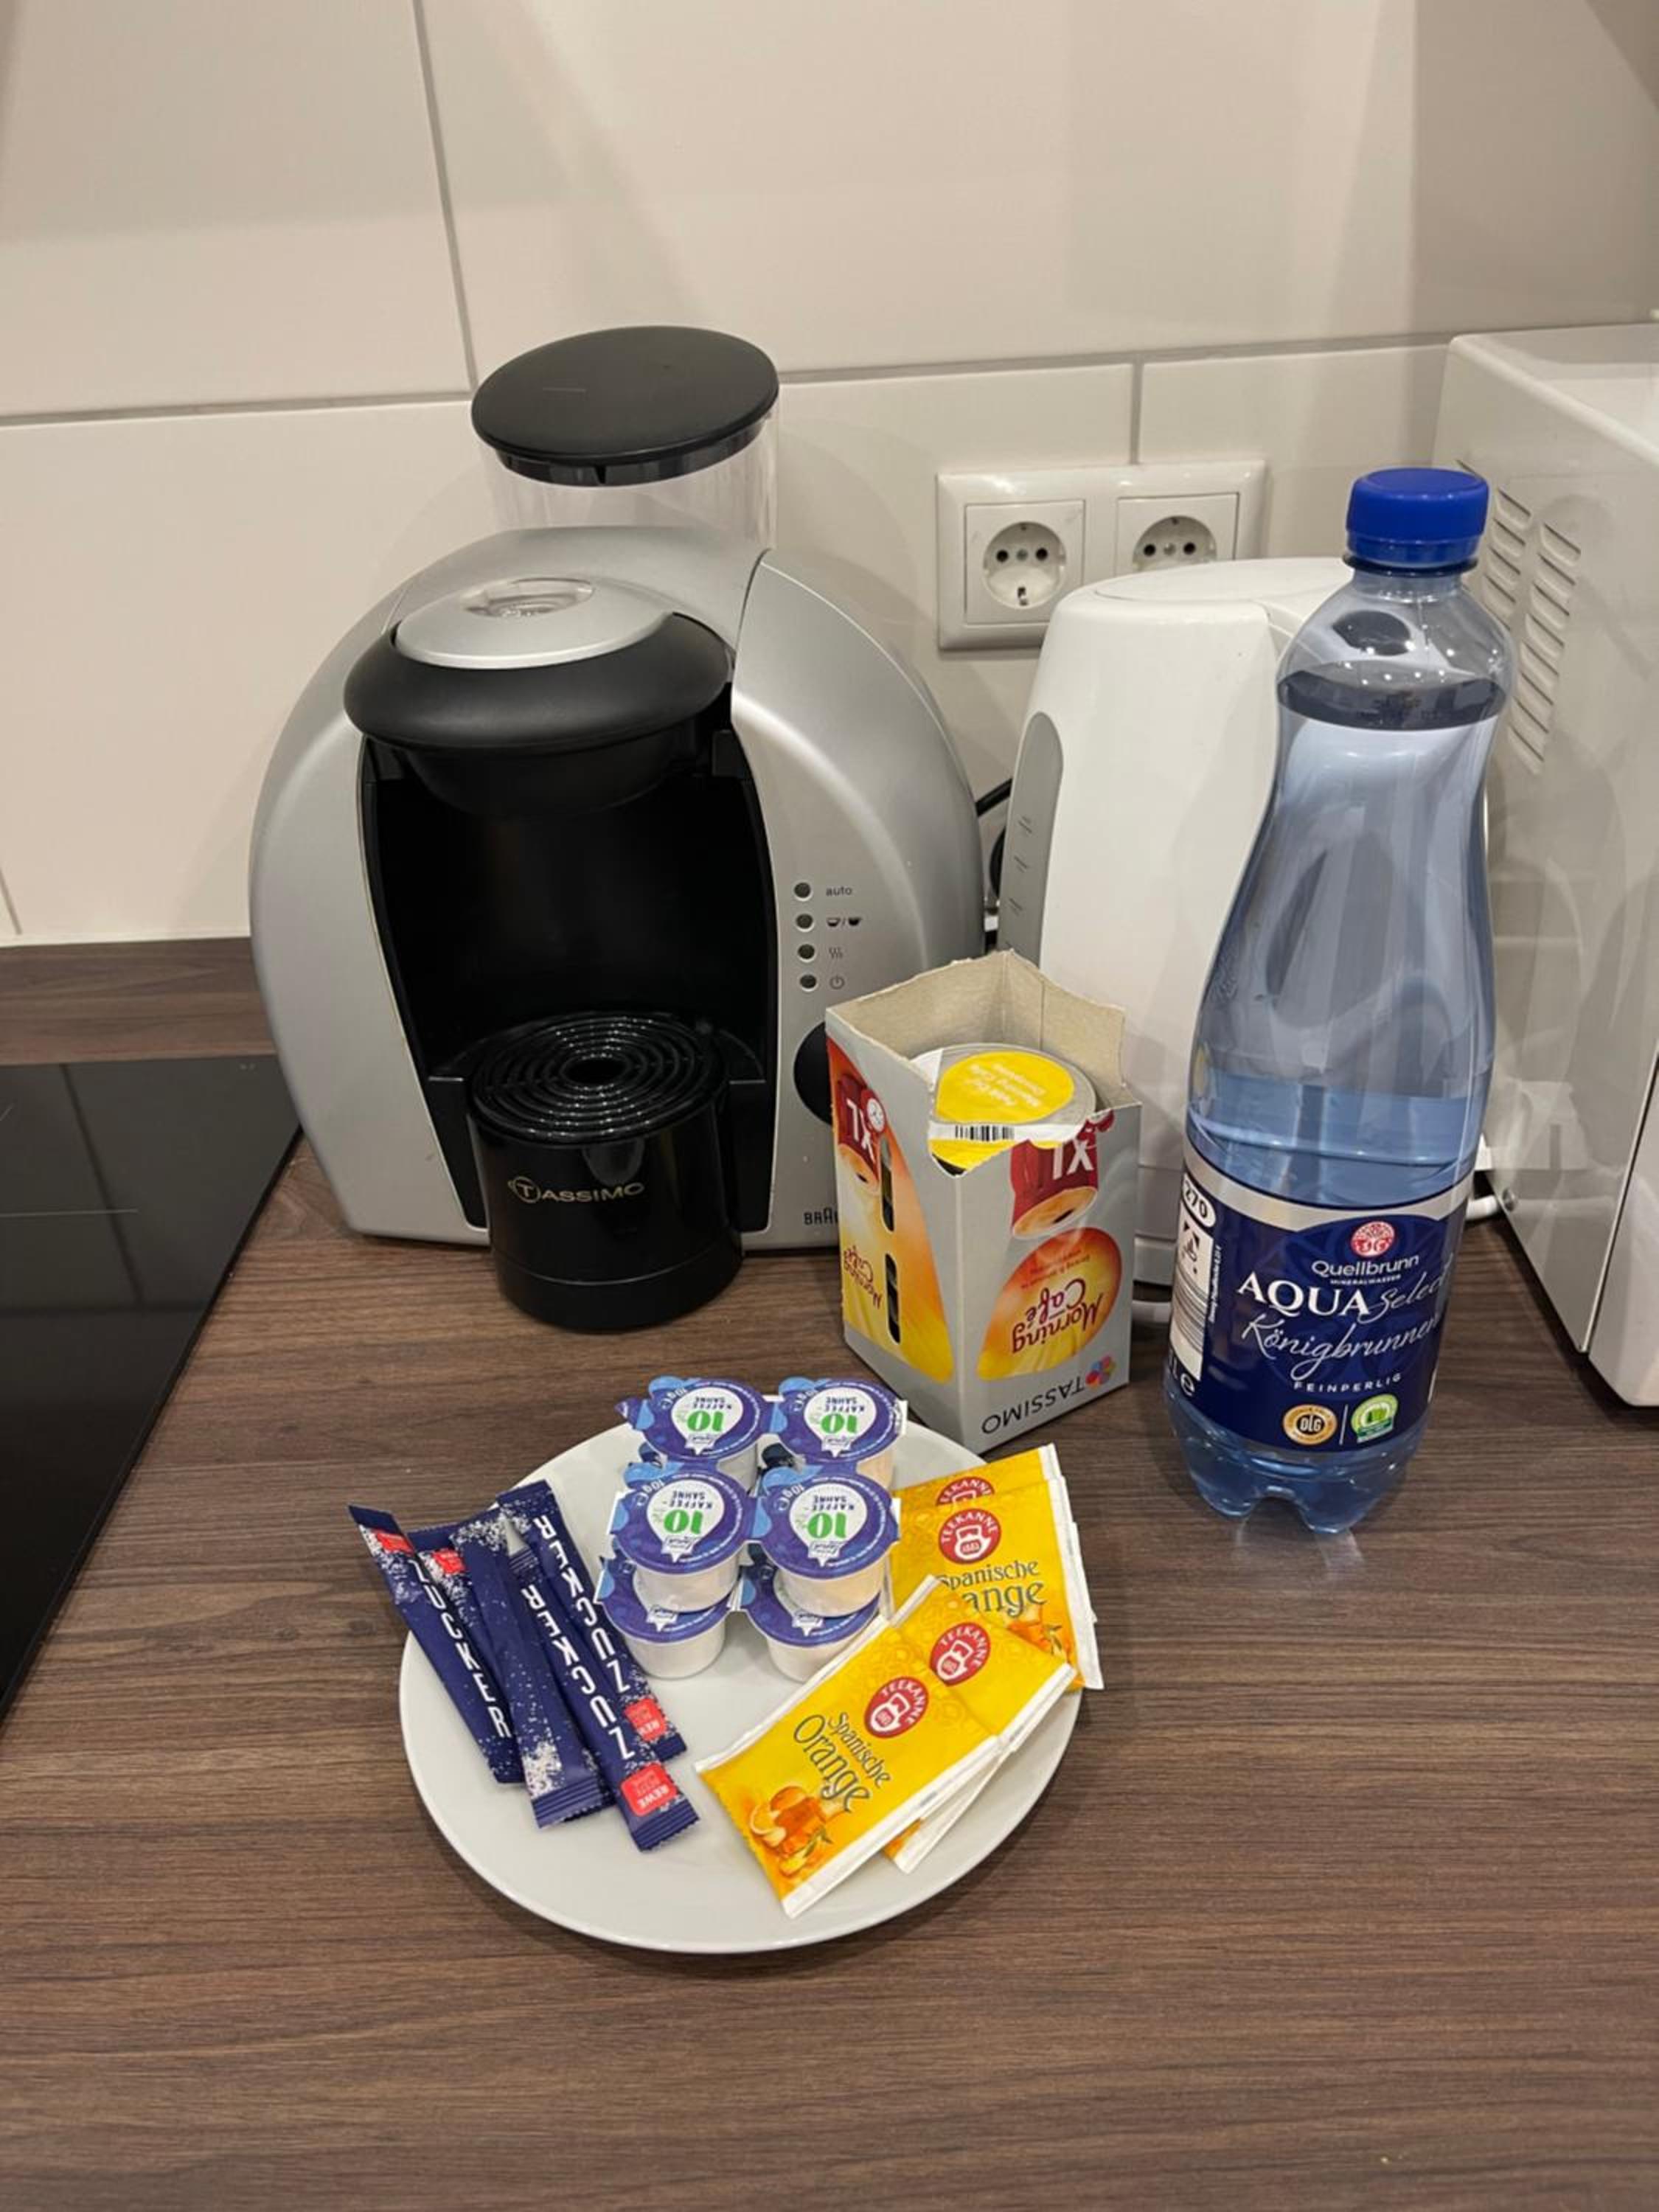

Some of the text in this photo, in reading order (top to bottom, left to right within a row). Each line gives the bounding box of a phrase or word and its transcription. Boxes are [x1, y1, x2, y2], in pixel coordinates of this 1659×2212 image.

[826, 886, 853, 897] auto
[509, 1177, 645, 1203] TASSIMO
[804, 1207, 838, 1225] BRA
[1311, 1255, 1419, 1277] Quellbrunn
[1026, 1278, 1086, 1329] Café
[1237, 1271, 1371, 1318] AQUA
[1012, 1293, 1105, 1354] Morning
[981, 1376, 1085, 1434] TASSIMO
[1294, 1372, 1402, 1393] FEINPERLIG
[941, 1512, 999, 1544] TEEKANNE
[533, 1514, 630, 1694] ZUCKER
[961, 1581, 1049, 1618] ange
[408, 1559, 512, 1739] ZUCKER
[940, 1625, 987, 1666] TEEKANNE
[521, 1584, 636, 1760] ZUCKER
[881, 1678, 926, 1724] TEEKANNE
[793, 1714, 871, 1814] Orange
[827, 1711, 892, 1790] Spanische
[639, 1784, 670, 1809] REWE
